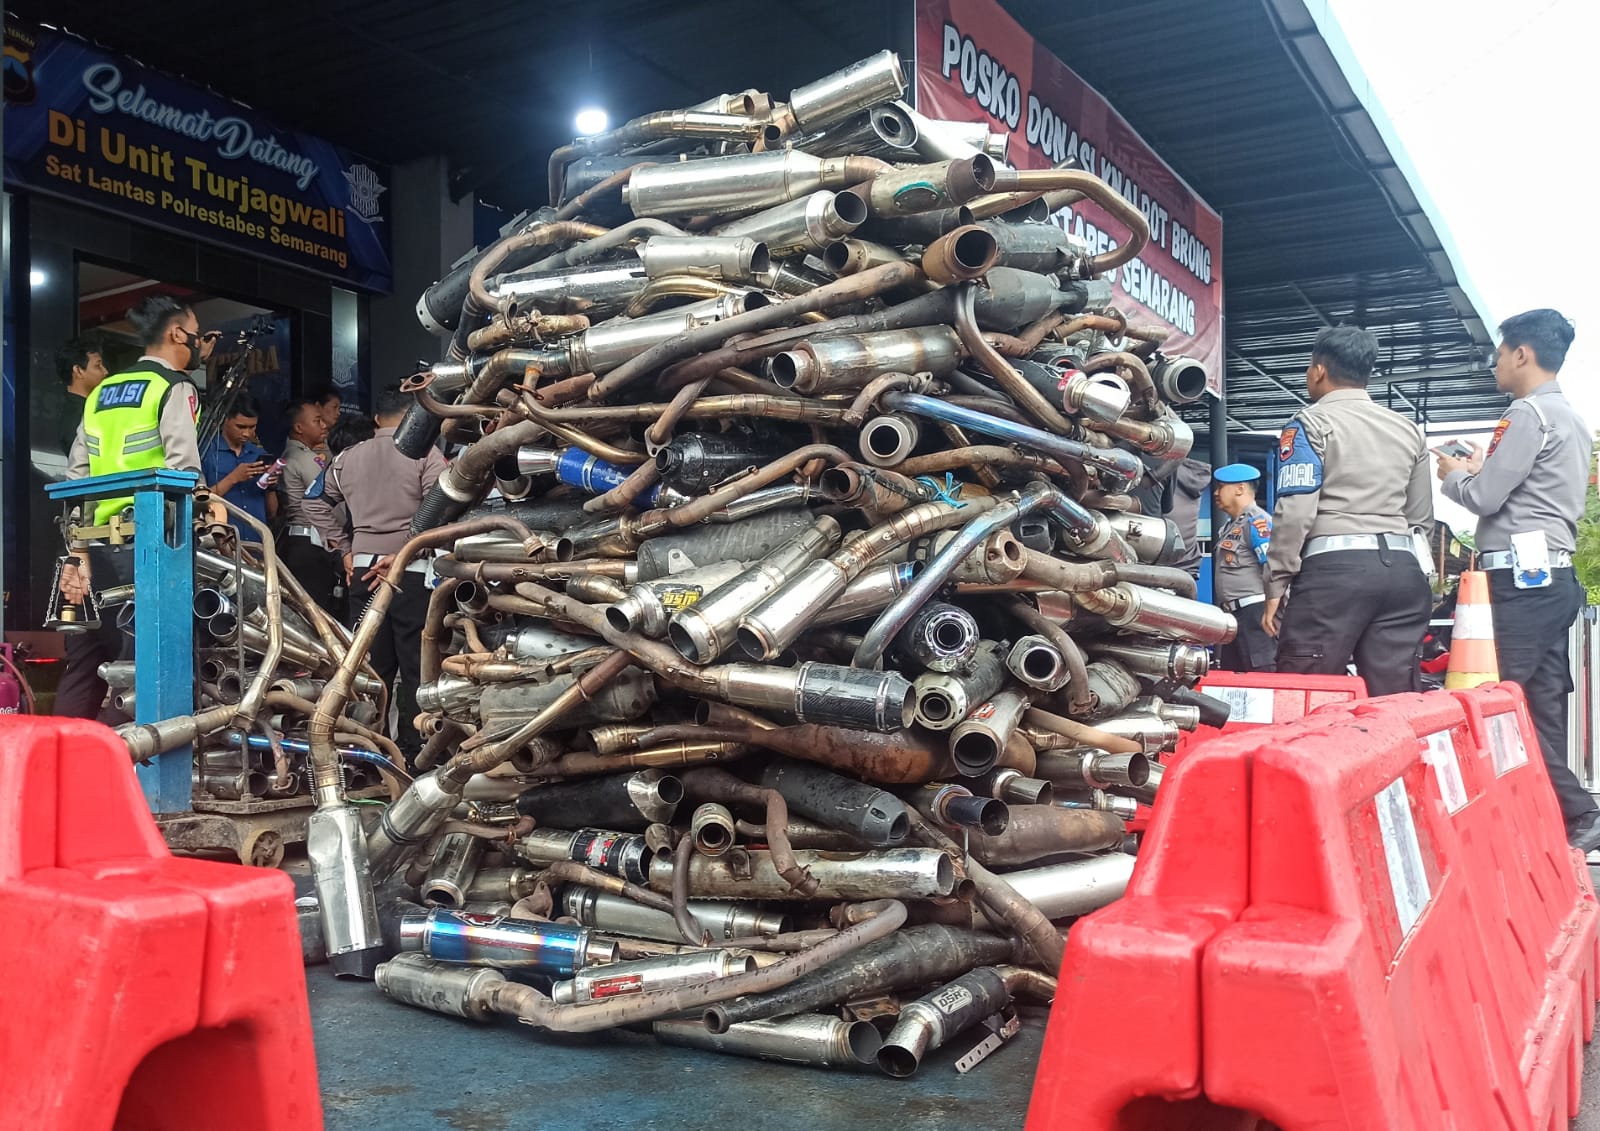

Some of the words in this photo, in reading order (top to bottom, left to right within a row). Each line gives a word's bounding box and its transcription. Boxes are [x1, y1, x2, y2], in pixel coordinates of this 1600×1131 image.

[48, 109, 87, 153] Di
[101, 128, 174, 182] Unit
[185, 157, 346, 239] Turjagwali
[82, 63, 215, 140] Selamat
[212, 116, 319, 190] Datang
[942, 23, 1021, 129] POSKO
[1026, 95, 1096, 176] DONASI
[1171, 221, 1212, 284] BRONG
[45, 155, 82, 184] Sat
[89, 173, 156, 206] Lantas
[162, 191, 265, 240] Polrestabes
[270, 226, 348, 269] Semarang
[1121, 258, 1196, 336] SEMARANG
[99, 383, 146, 406] POLISI
[939, 989, 963, 1008] DSR
